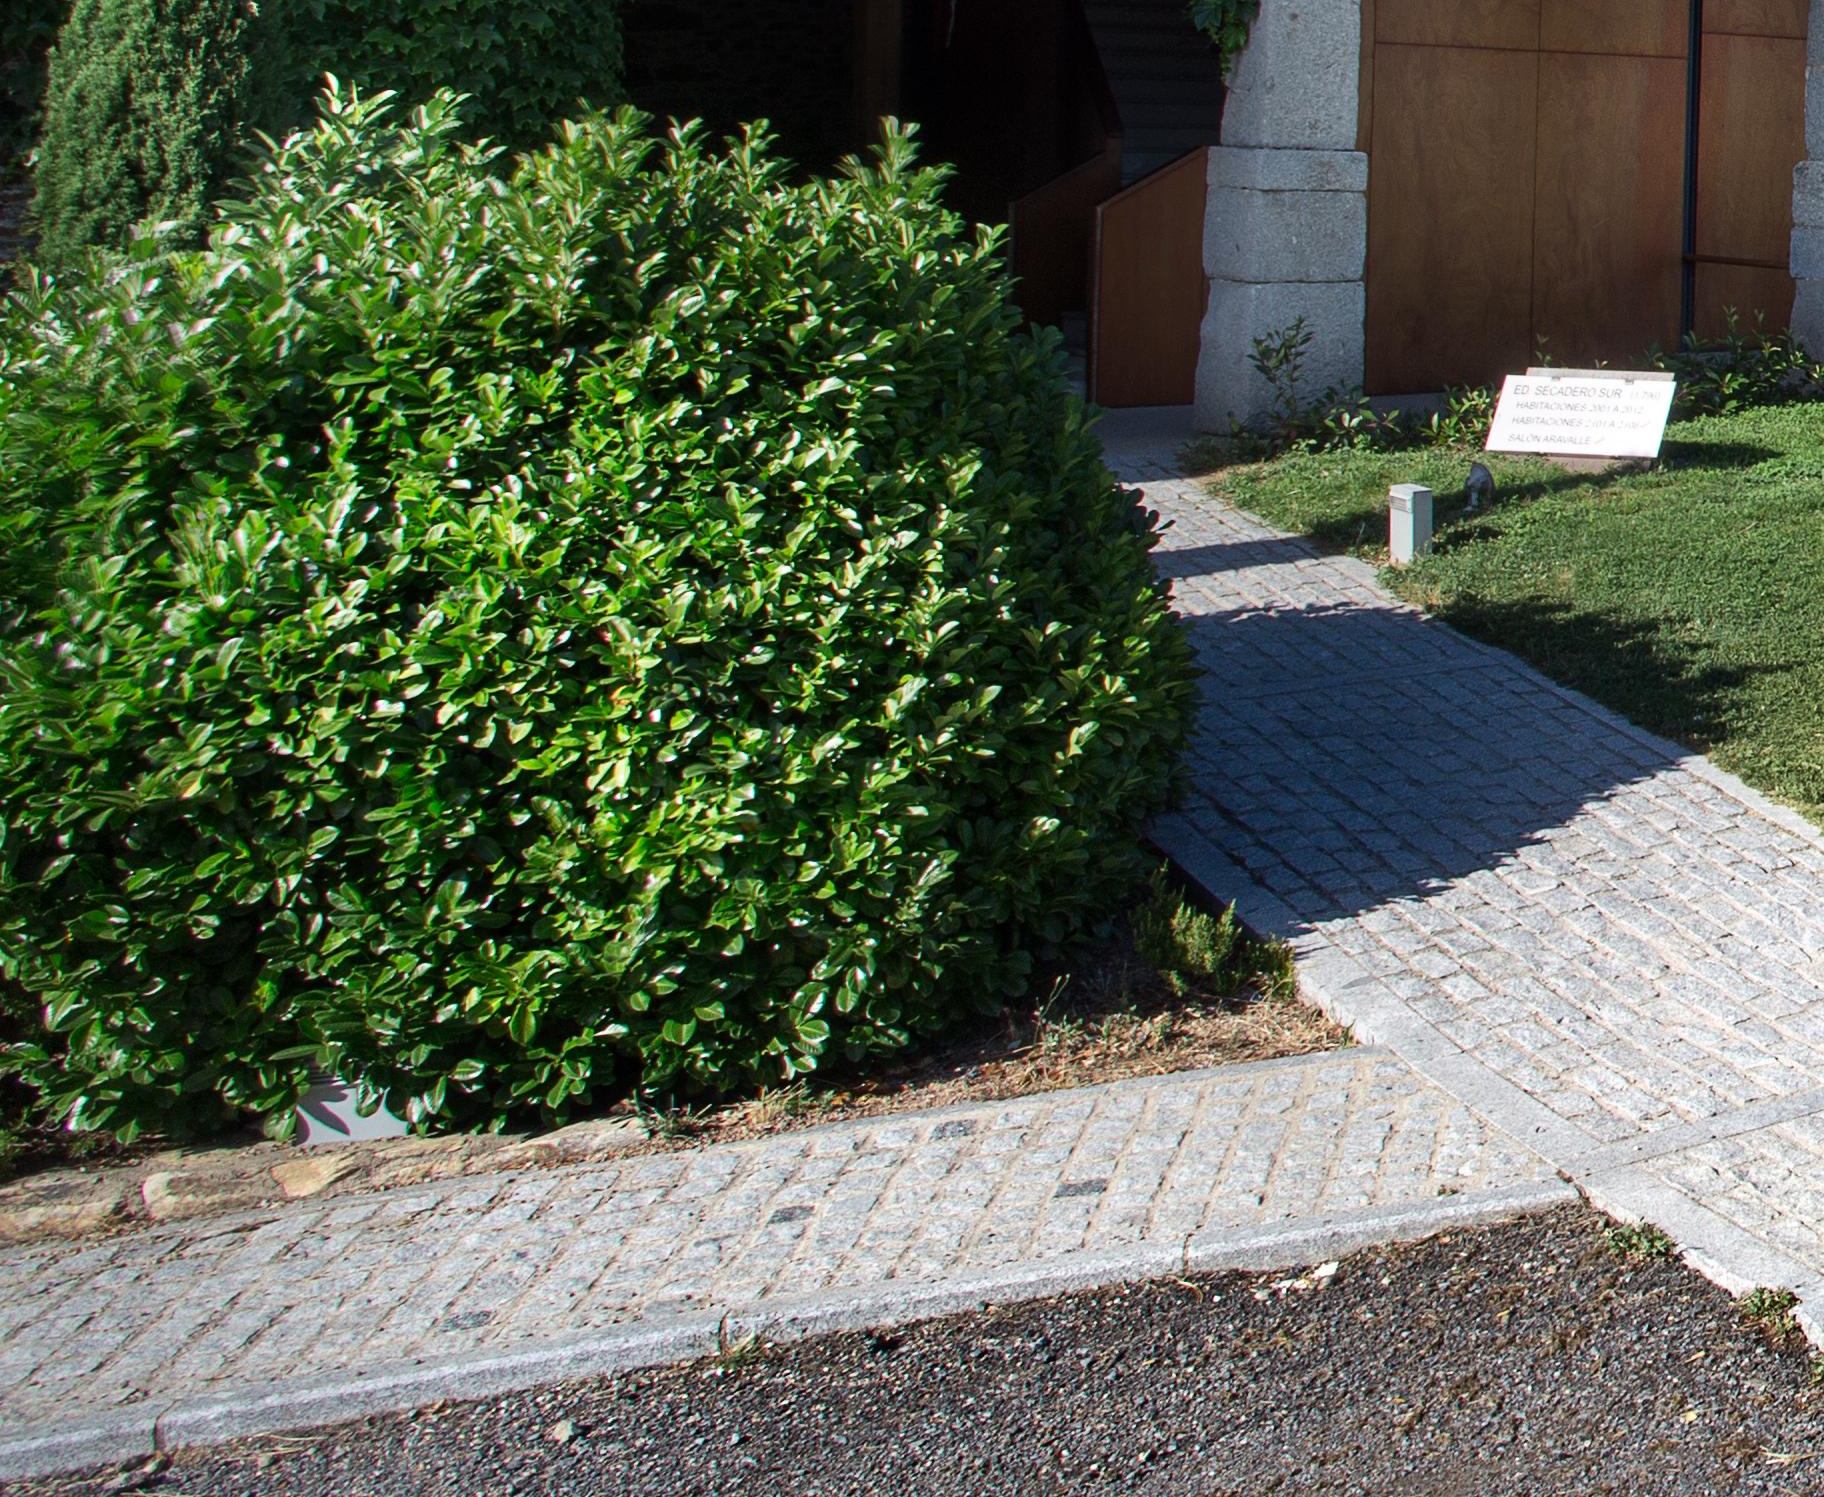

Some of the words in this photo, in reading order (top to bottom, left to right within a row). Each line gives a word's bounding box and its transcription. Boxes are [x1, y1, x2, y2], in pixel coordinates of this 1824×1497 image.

[1535, 385, 1597, 398] SECADERO
[1598, 387, 1623, 399] SUR
[1516, 401, 1586, 412] HABITACIONES
[1612, 404, 1619, 412] A
[1512, 416, 1583, 427] HABITACIONES
[1608, 419, 1616, 428] A
[1542, 434, 1592, 445] ARAVALLE
